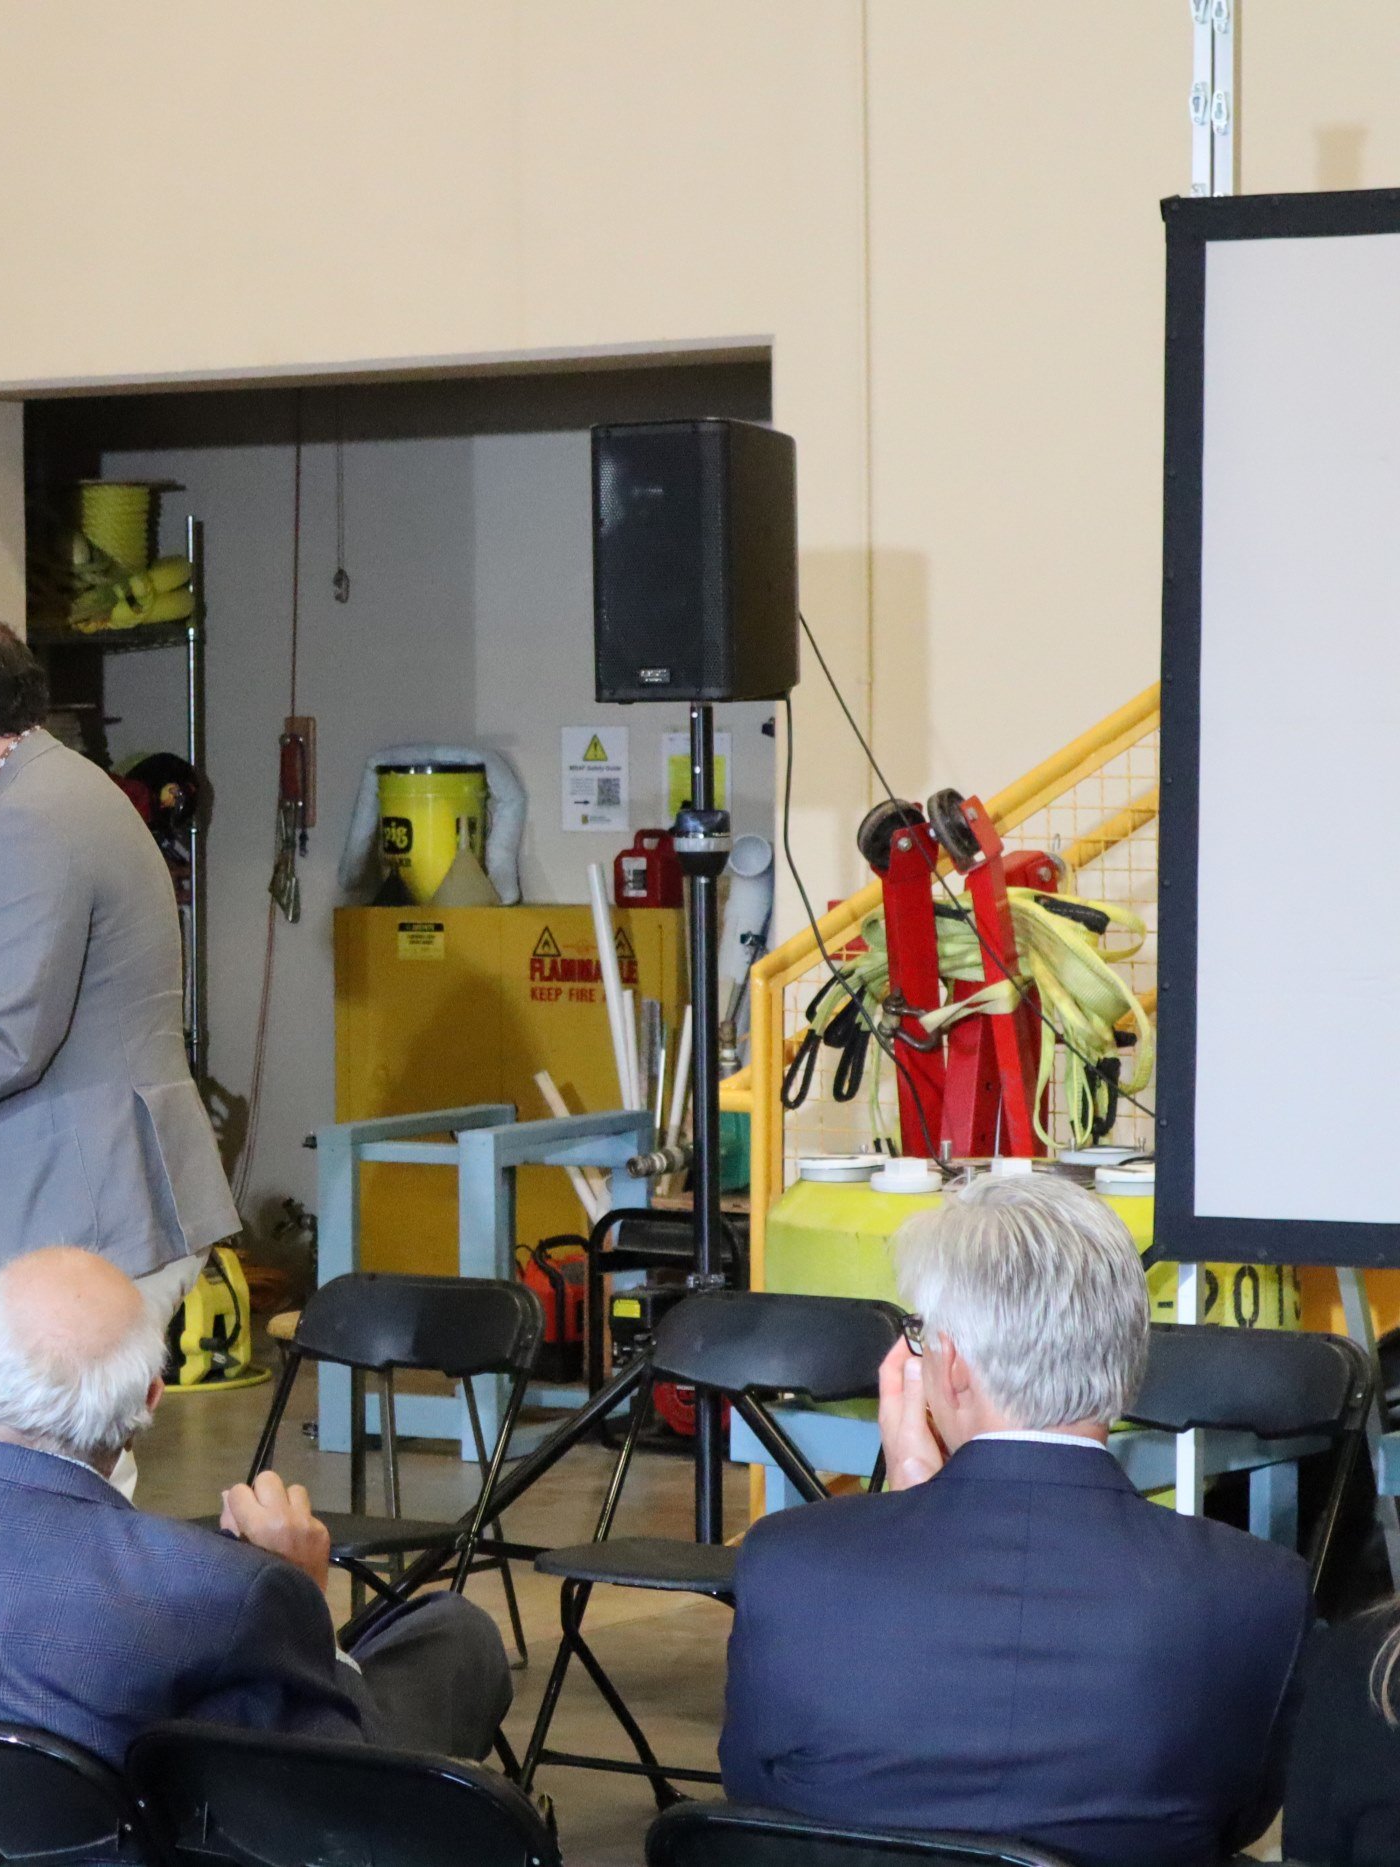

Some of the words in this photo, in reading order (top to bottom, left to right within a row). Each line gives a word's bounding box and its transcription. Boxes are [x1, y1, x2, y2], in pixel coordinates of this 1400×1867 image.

[530, 958, 638, 984] FLAMMALE
[531, 987, 562, 1001] KEEP
[568, 988, 596, 1003] FIRE
